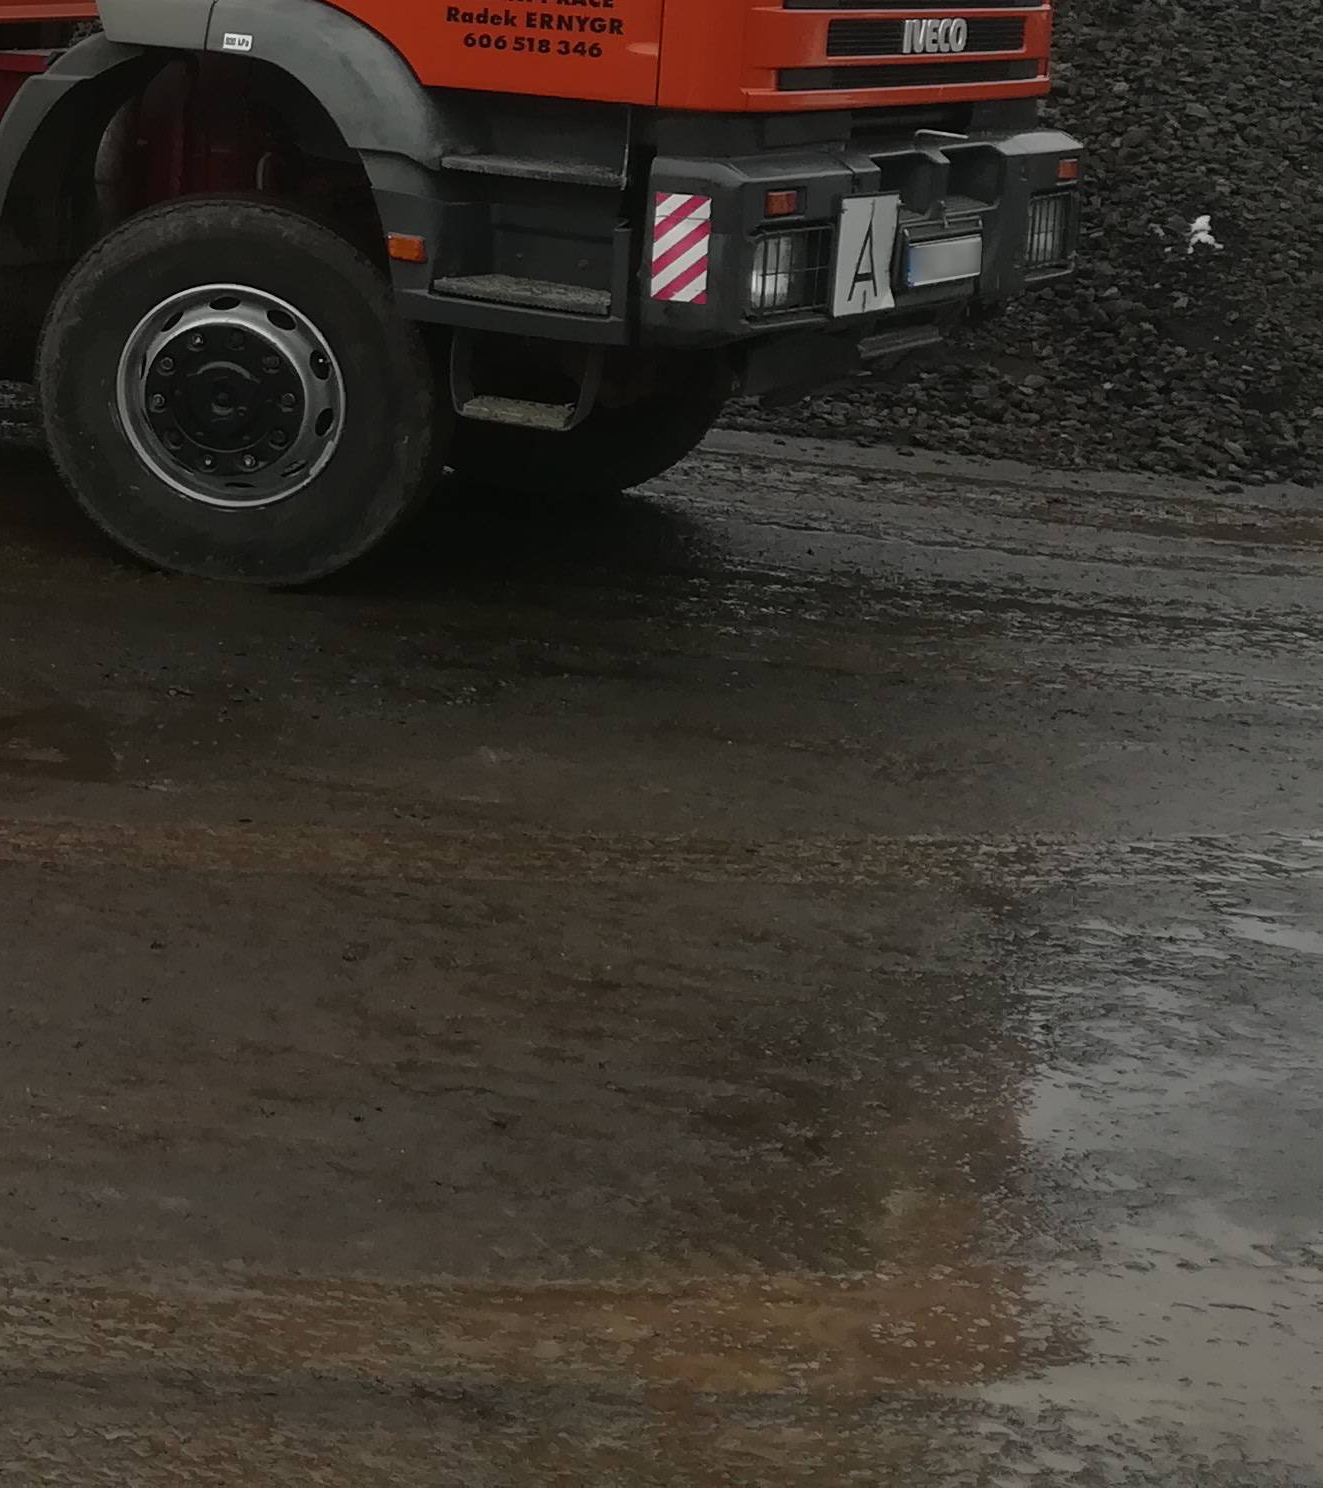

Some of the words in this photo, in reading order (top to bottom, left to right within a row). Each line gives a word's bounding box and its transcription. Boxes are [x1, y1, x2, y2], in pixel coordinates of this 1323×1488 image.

[446, 6, 517, 28] Radek
[525, 12, 624, 36] ERNYGR
[902, 18, 968, 54] IVECO
[463, 32, 508, 51] 606
[512, 36, 551, 54] 518
[557, 39, 603, 58] 346
